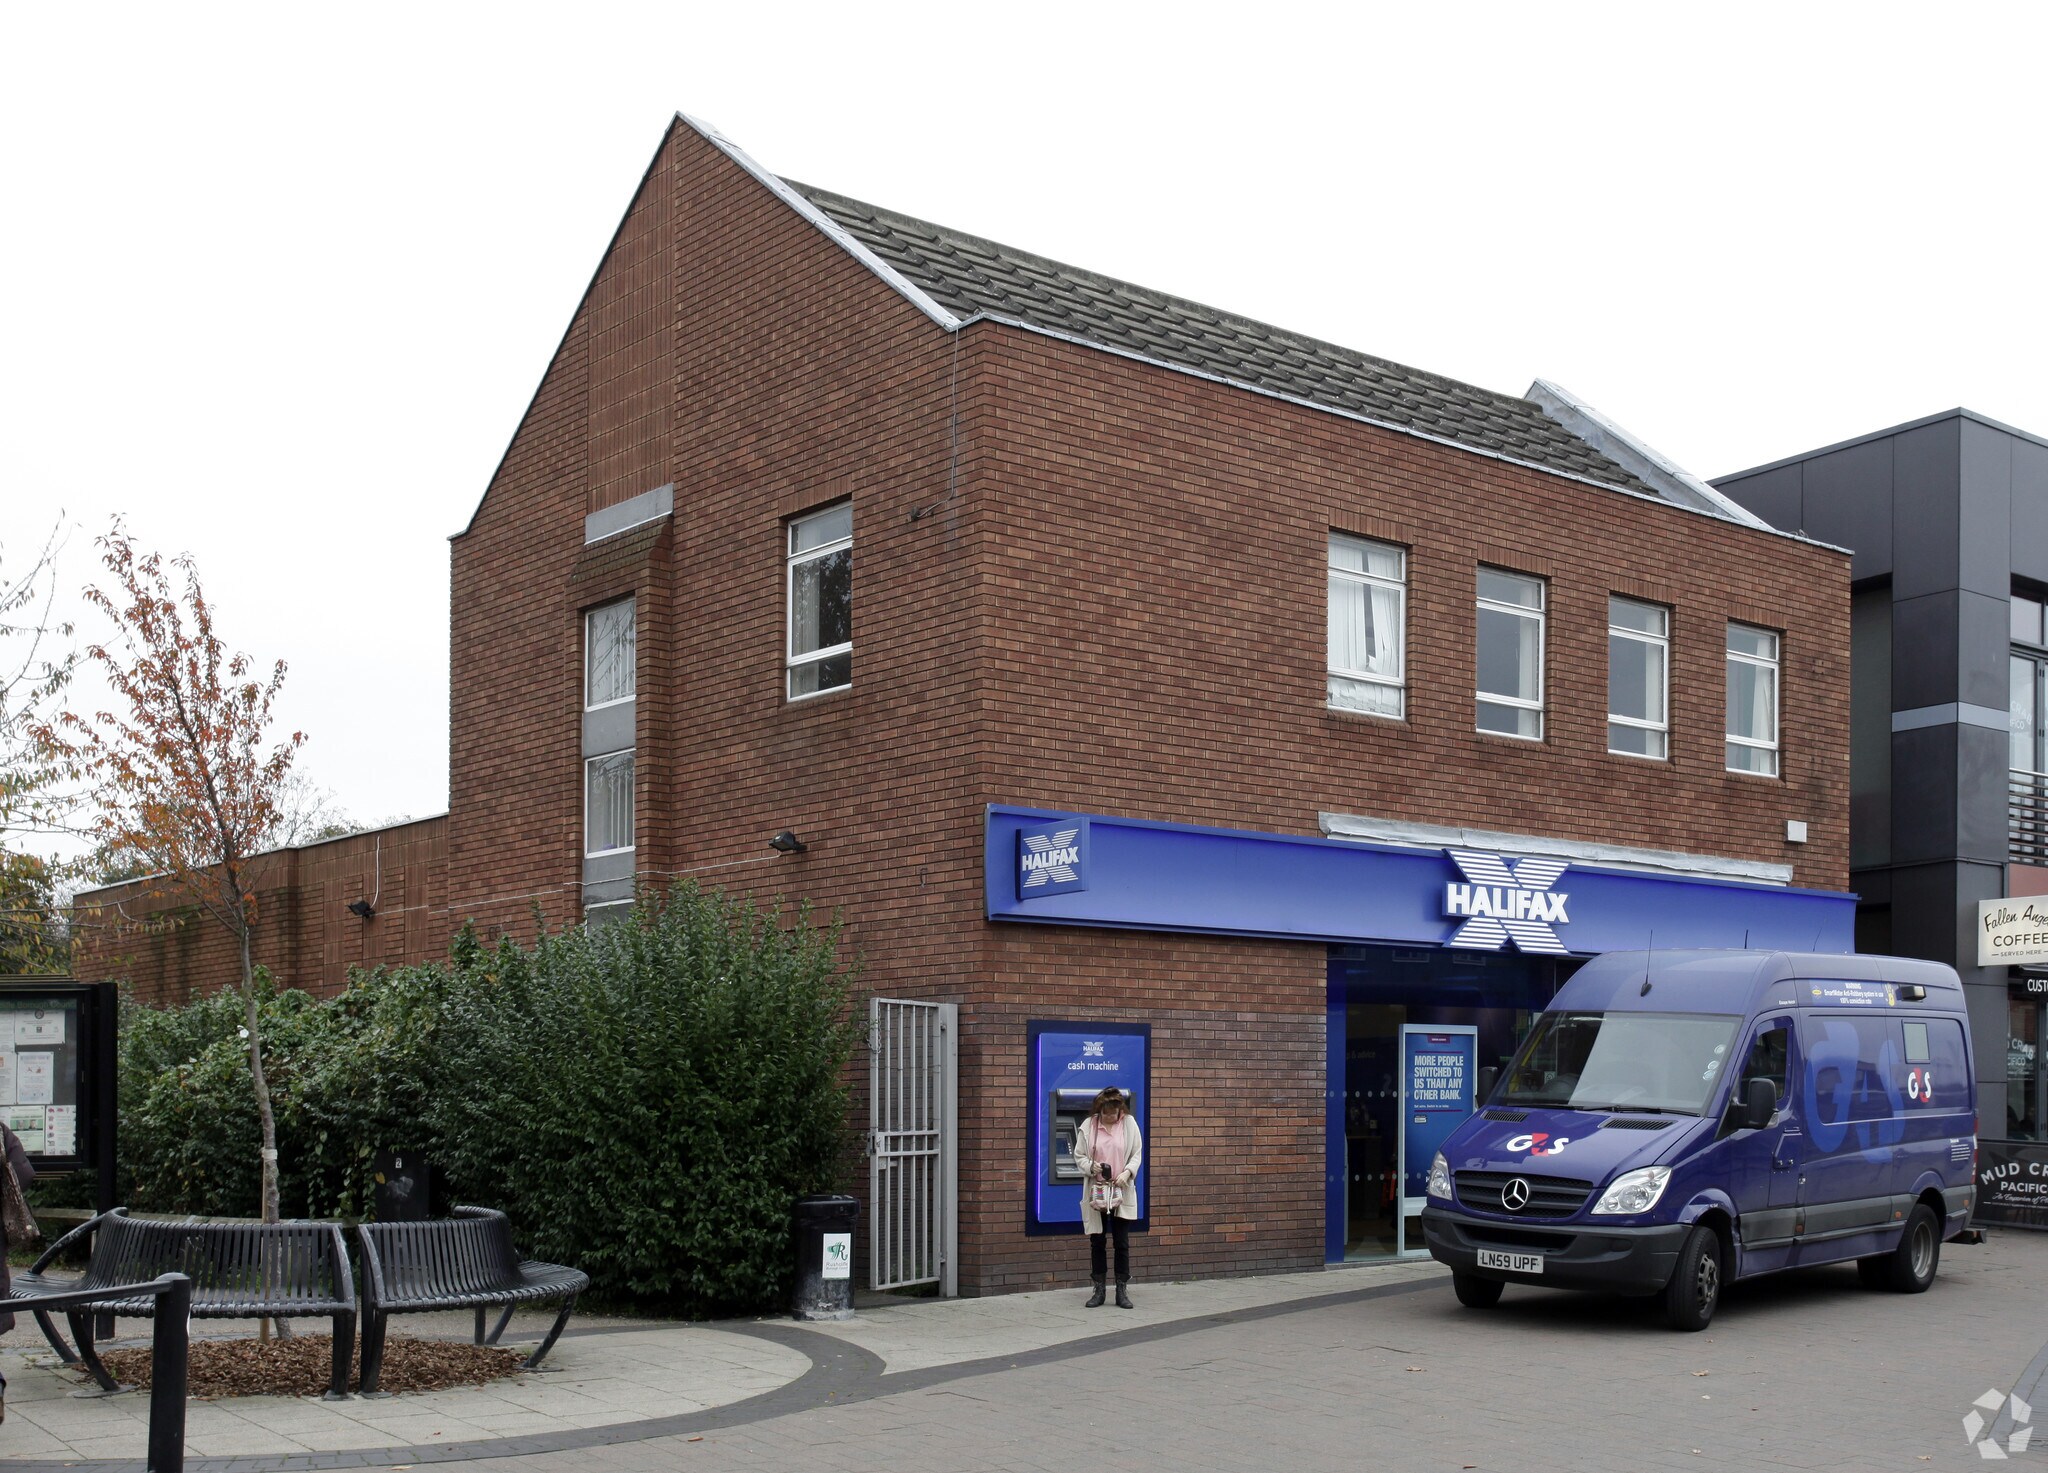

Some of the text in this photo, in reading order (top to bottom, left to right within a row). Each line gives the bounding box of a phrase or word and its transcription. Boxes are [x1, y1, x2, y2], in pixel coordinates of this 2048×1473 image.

[1022, 846, 1079, 871] HALIFAX
[1447, 883, 1570, 924] HALIFAX
[1984, 907, 2018, 933] Fallen
[1993, 932, 2048, 947] COFFEE
[2027, 979, 2048, 992] CUST
[1068, 1061, 1119, 1071] cash machine
[1414, 1055, 1464, 1066] MORE PEOPLE
[1414, 1067, 1462, 1078] SWITCHED TO
[1414, 1078, 1463, 1089] US THAN ANY
[1414, 1089, 1461, 1100] OTHER BANK.
[1506, 1132, 1570, 1157] G4S
[1980, 1162, 2020, 1185] MUD
[1482, 1252, 1538, 1270] LN59 UPF
